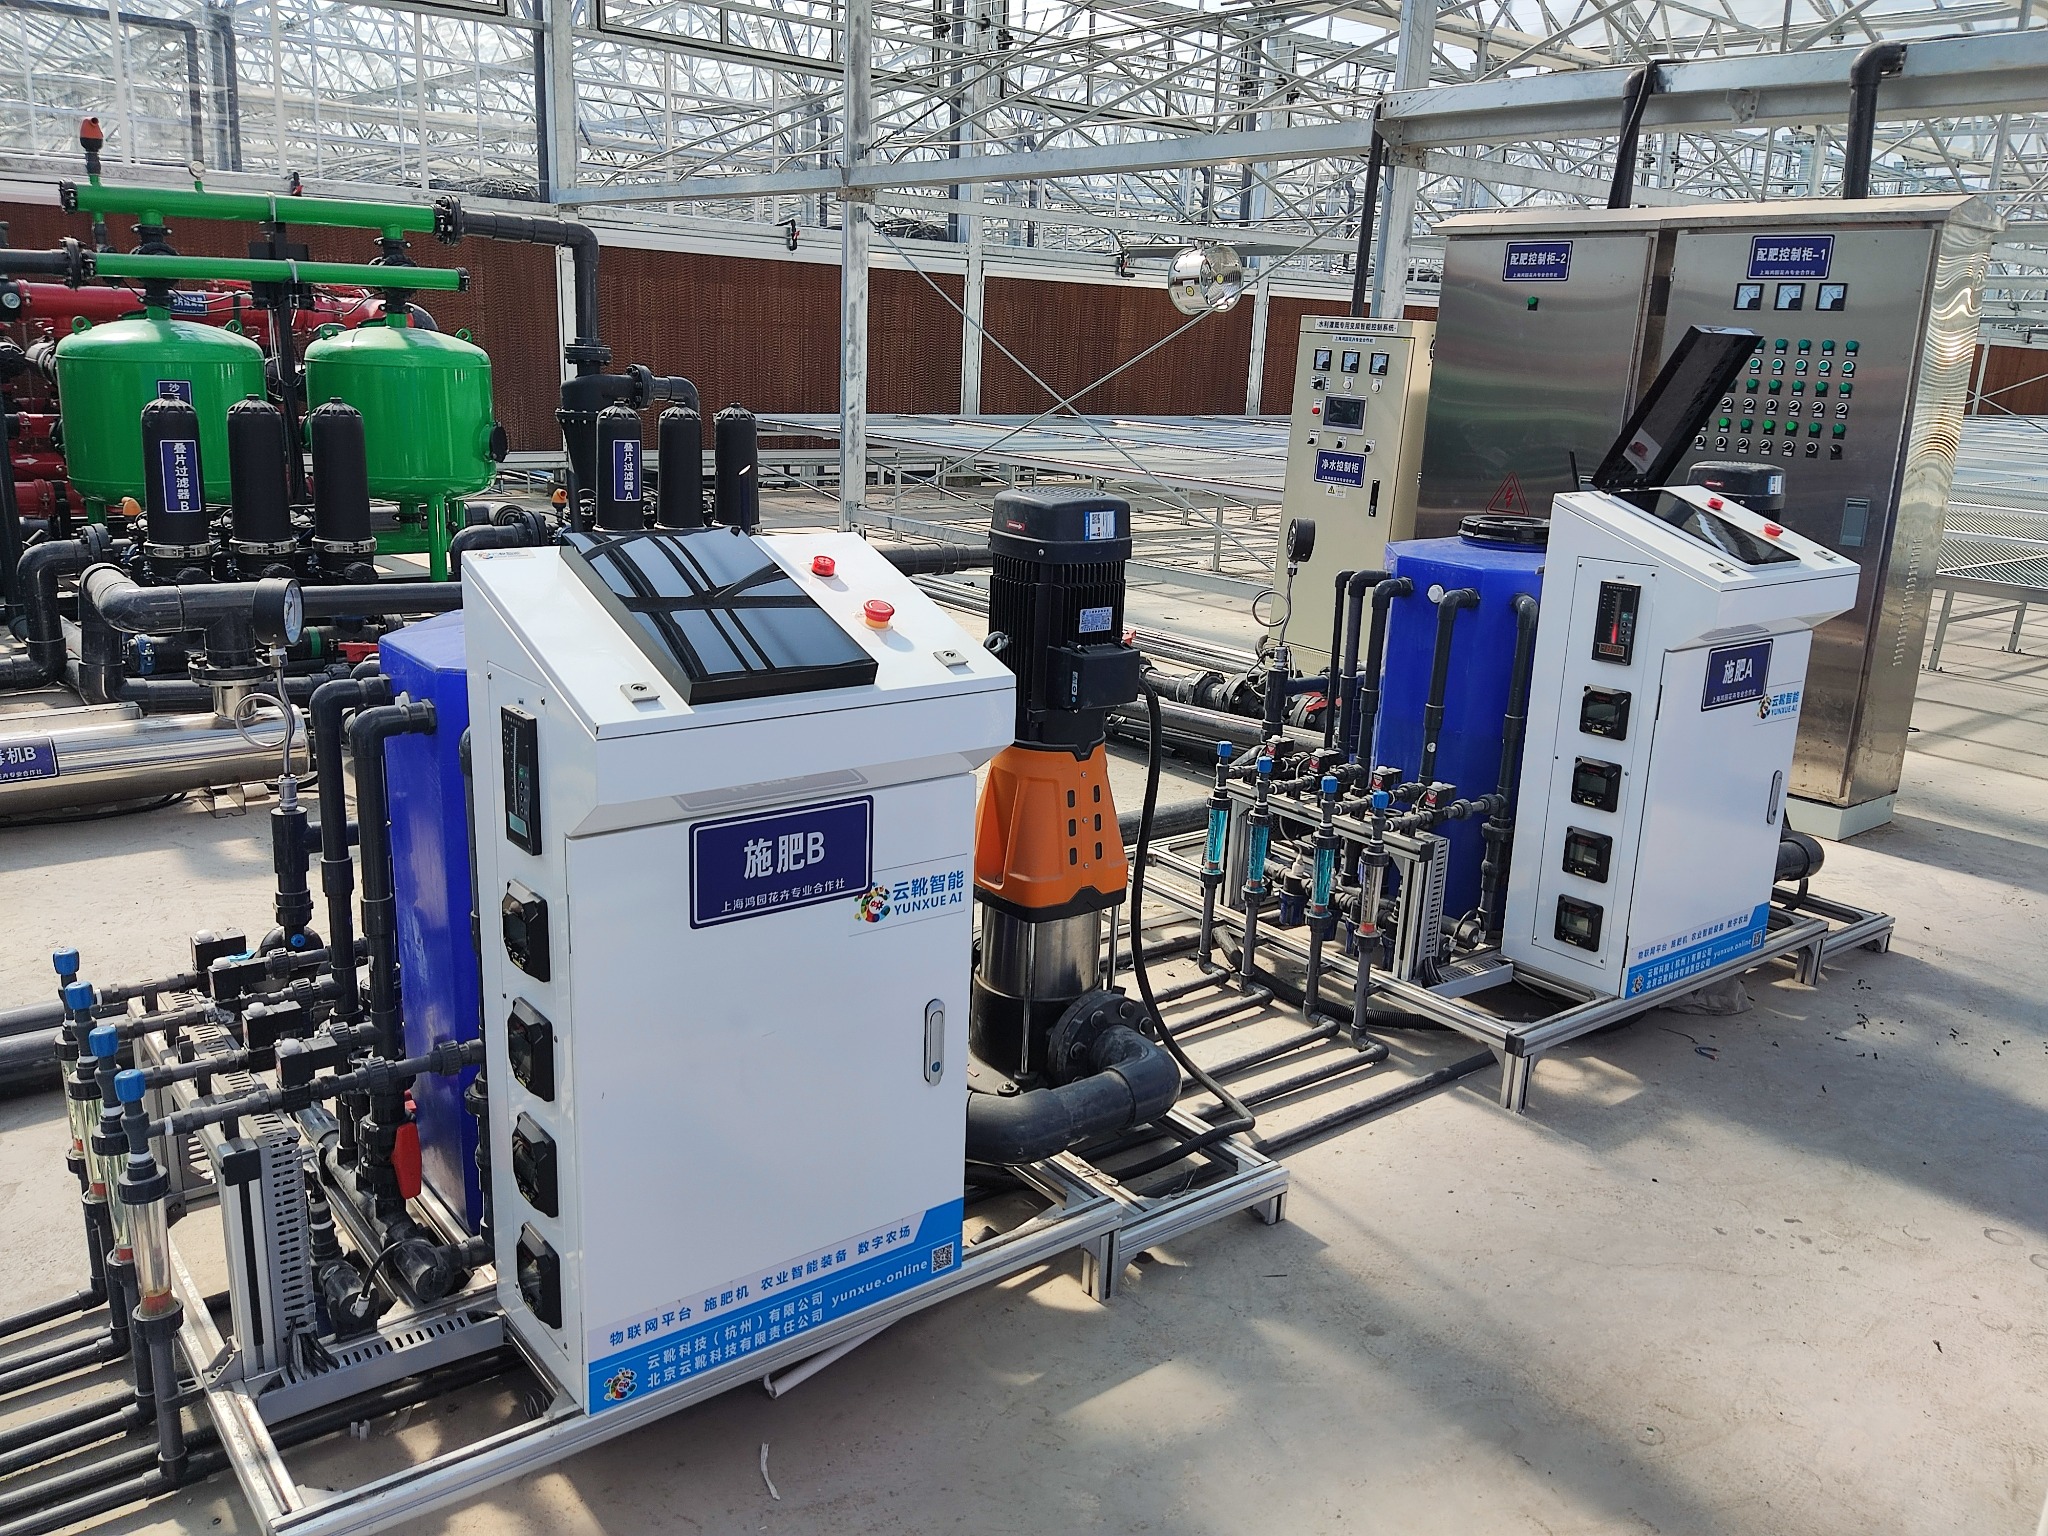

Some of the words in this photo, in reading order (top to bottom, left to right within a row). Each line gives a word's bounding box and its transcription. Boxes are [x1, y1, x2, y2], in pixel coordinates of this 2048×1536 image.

[1510, 251, 1567, 266] 配肥控制柜-2
[1756, 247, 1826, 262] 配肥控制柜-1
[173, 442, 190, 511] 叠片过滤器B
[1321, 458, 1360, 474] 净水控制柜
[1722, 658, 1753, 684] 施肥A
[743, 831, 825, 880] 施肥B
[721, 878, 845, 913] 上海鸿园花卉专业合作社
[892, 870, 964, 902] 云靴智能
[894, 894, 947, 916] YUNXUE
[949, 891, 963, 905] AI
[1713, 938, 1752, 960] yunxue.online
[609, 1306, 692, 1347] 物联网平台
[704, 1285, 749, 1313] 施肥机
[760, 1249, 848, 1291] 农业智能装备
[857, 1224, 911, 1256] 数字农场
[831, 1259, 928, 1308] yunxue.online
[647, 1290, 823, 1370] 云靴科技（杭州）有限公司
[647, 1308, 823, 1389] 北京云靴科技有限责任公司
